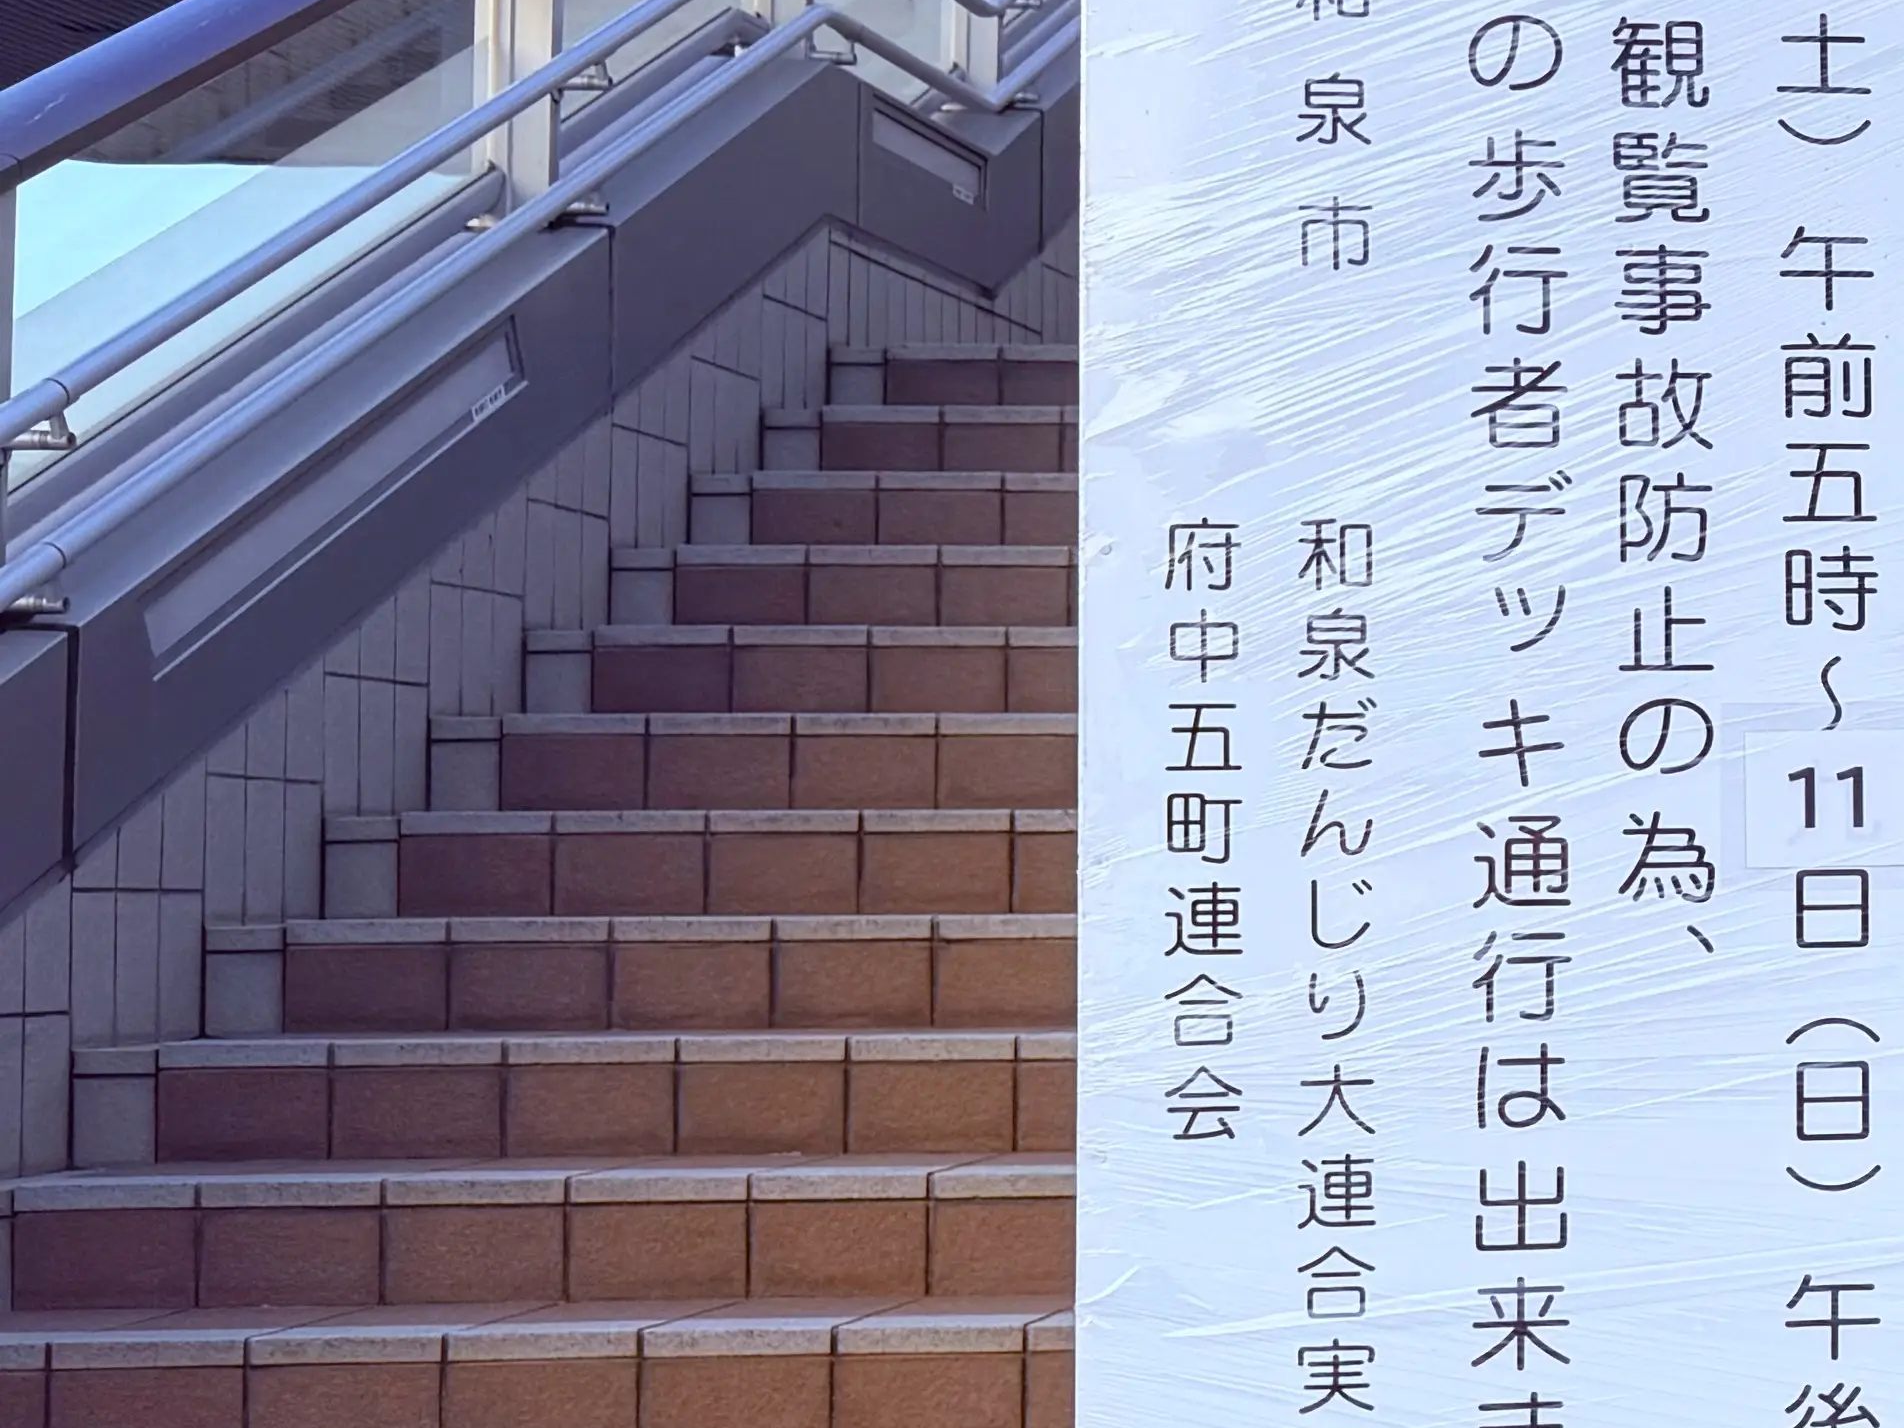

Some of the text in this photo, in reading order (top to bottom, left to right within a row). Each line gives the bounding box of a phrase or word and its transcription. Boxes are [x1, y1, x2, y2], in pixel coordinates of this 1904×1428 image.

[1163, 516, 1245, 1141] 府中五町連合会
